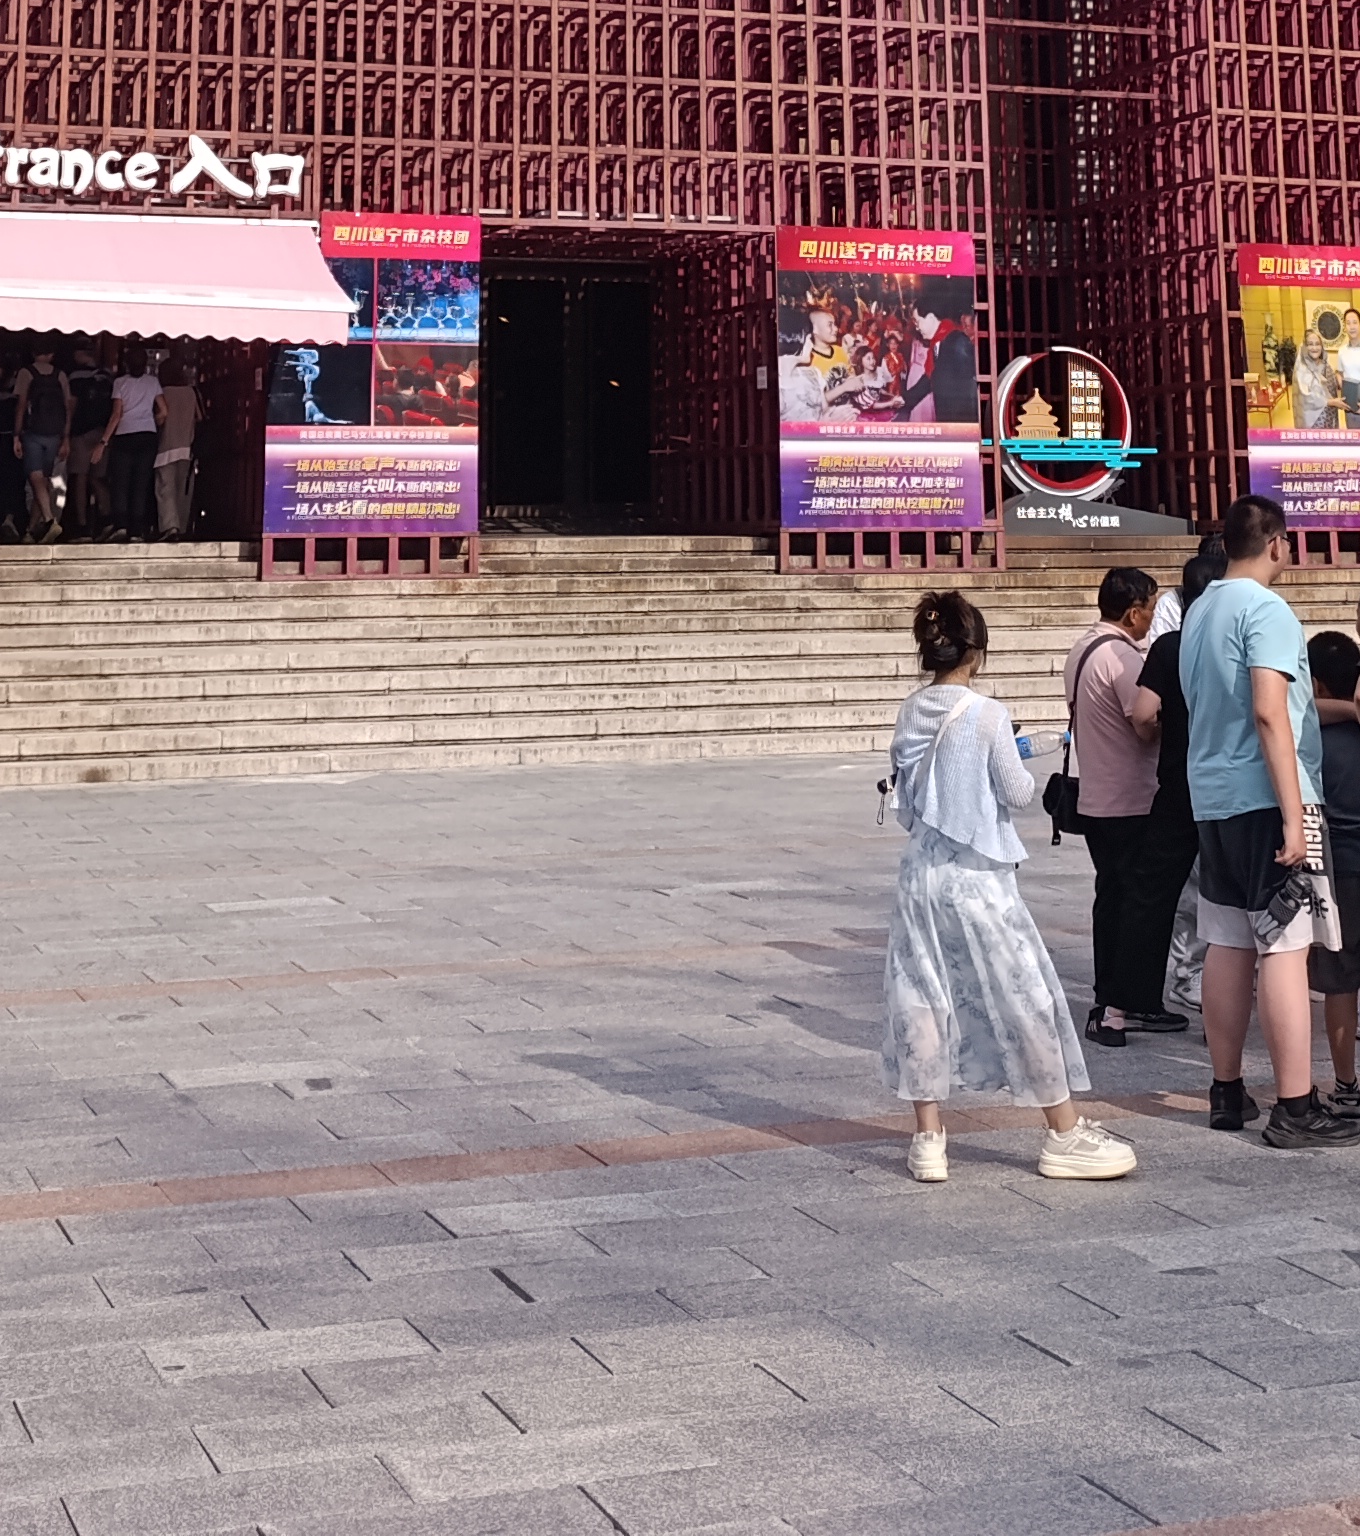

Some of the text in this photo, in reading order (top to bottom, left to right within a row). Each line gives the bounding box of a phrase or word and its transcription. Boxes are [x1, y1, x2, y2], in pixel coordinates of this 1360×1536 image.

[169, 134, 305, 199] 入口
[333, 226, 470, 245] 四川遂宁市杂技团
[799, 240, 953, 262] 四川遂宁市杂技团
[1017, 503, 1120, 528] 社会主义核心价值观
